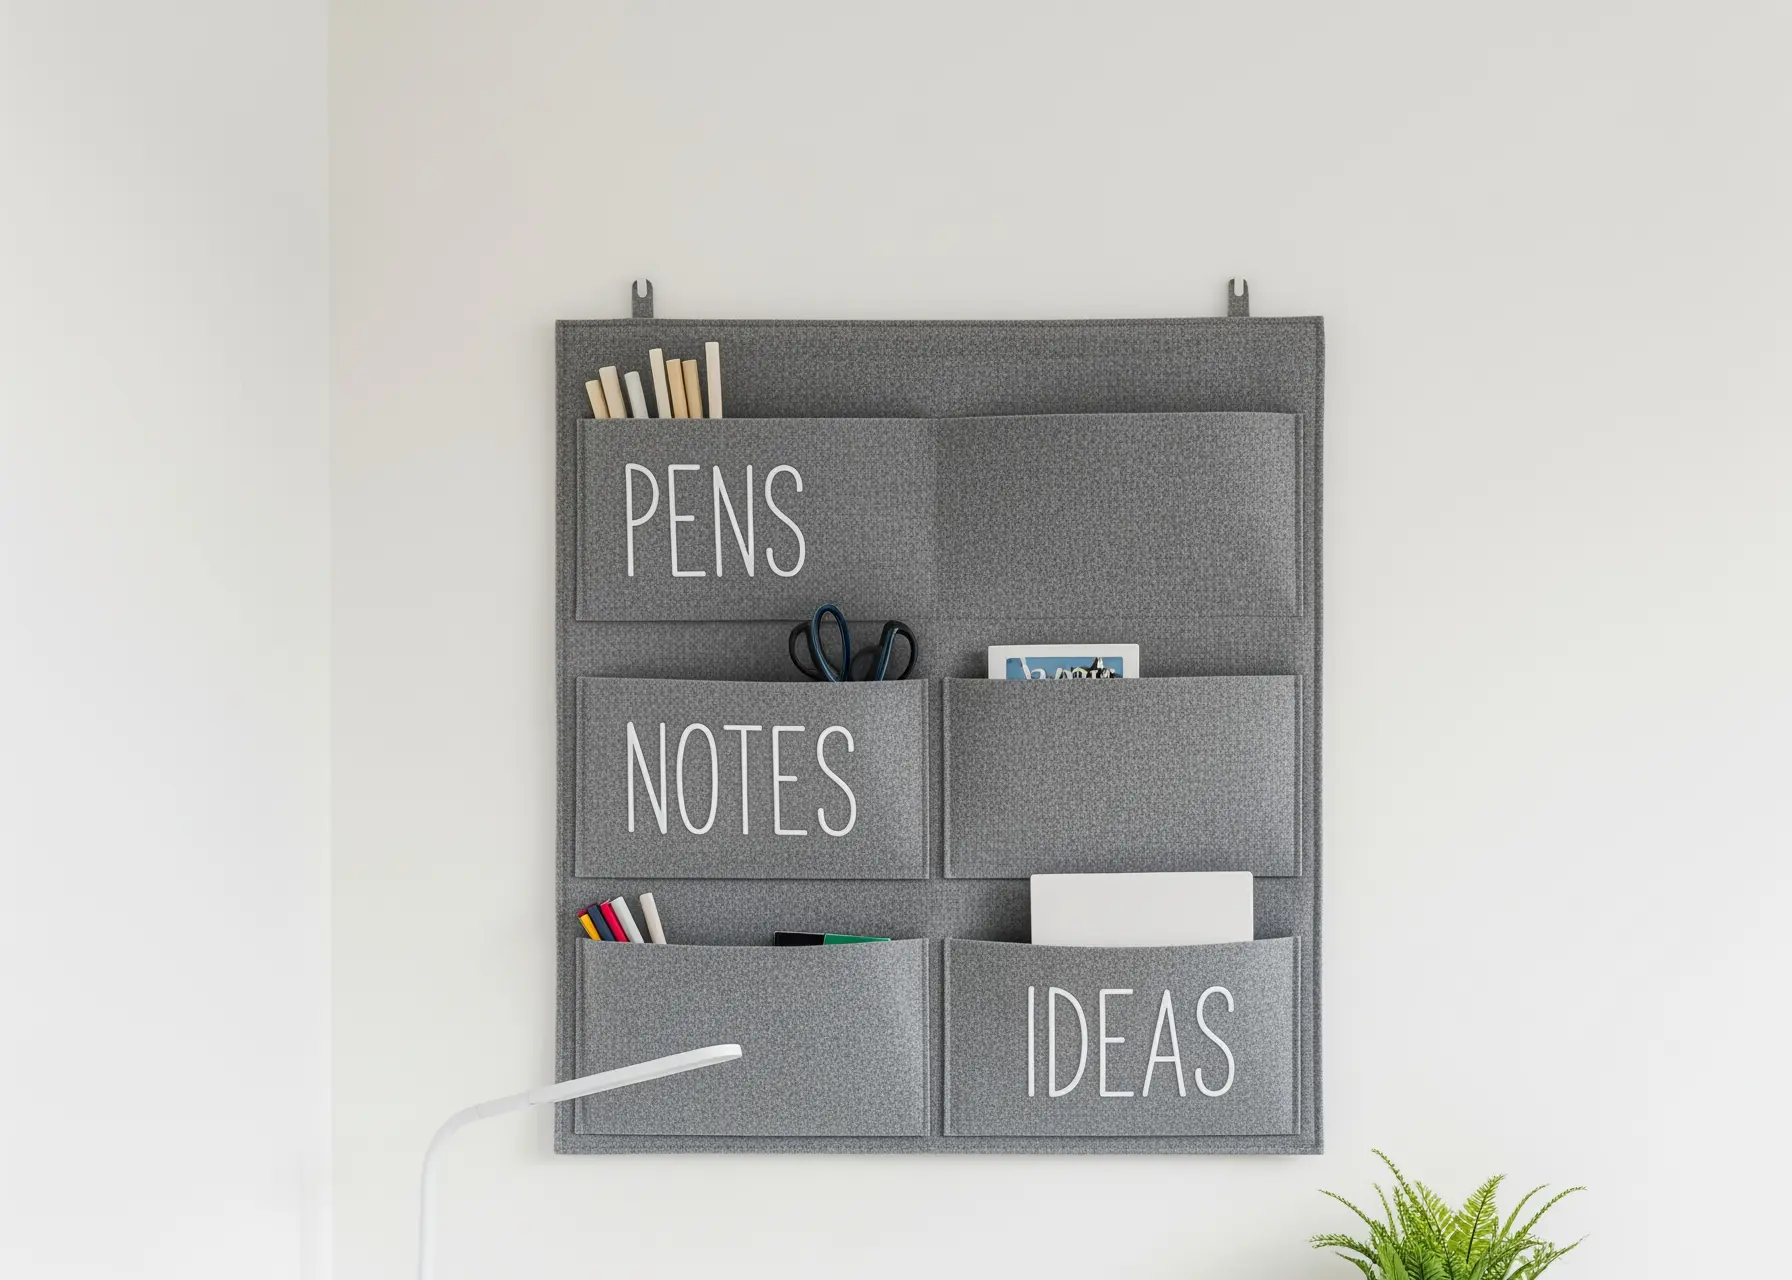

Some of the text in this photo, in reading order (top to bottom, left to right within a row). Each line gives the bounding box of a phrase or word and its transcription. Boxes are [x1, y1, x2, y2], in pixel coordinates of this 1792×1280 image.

[624, 463, 807, 578] PENS
[625, 721, 858, 837] NOTES
[1027, 985, 1236, 1098] IDEAS
